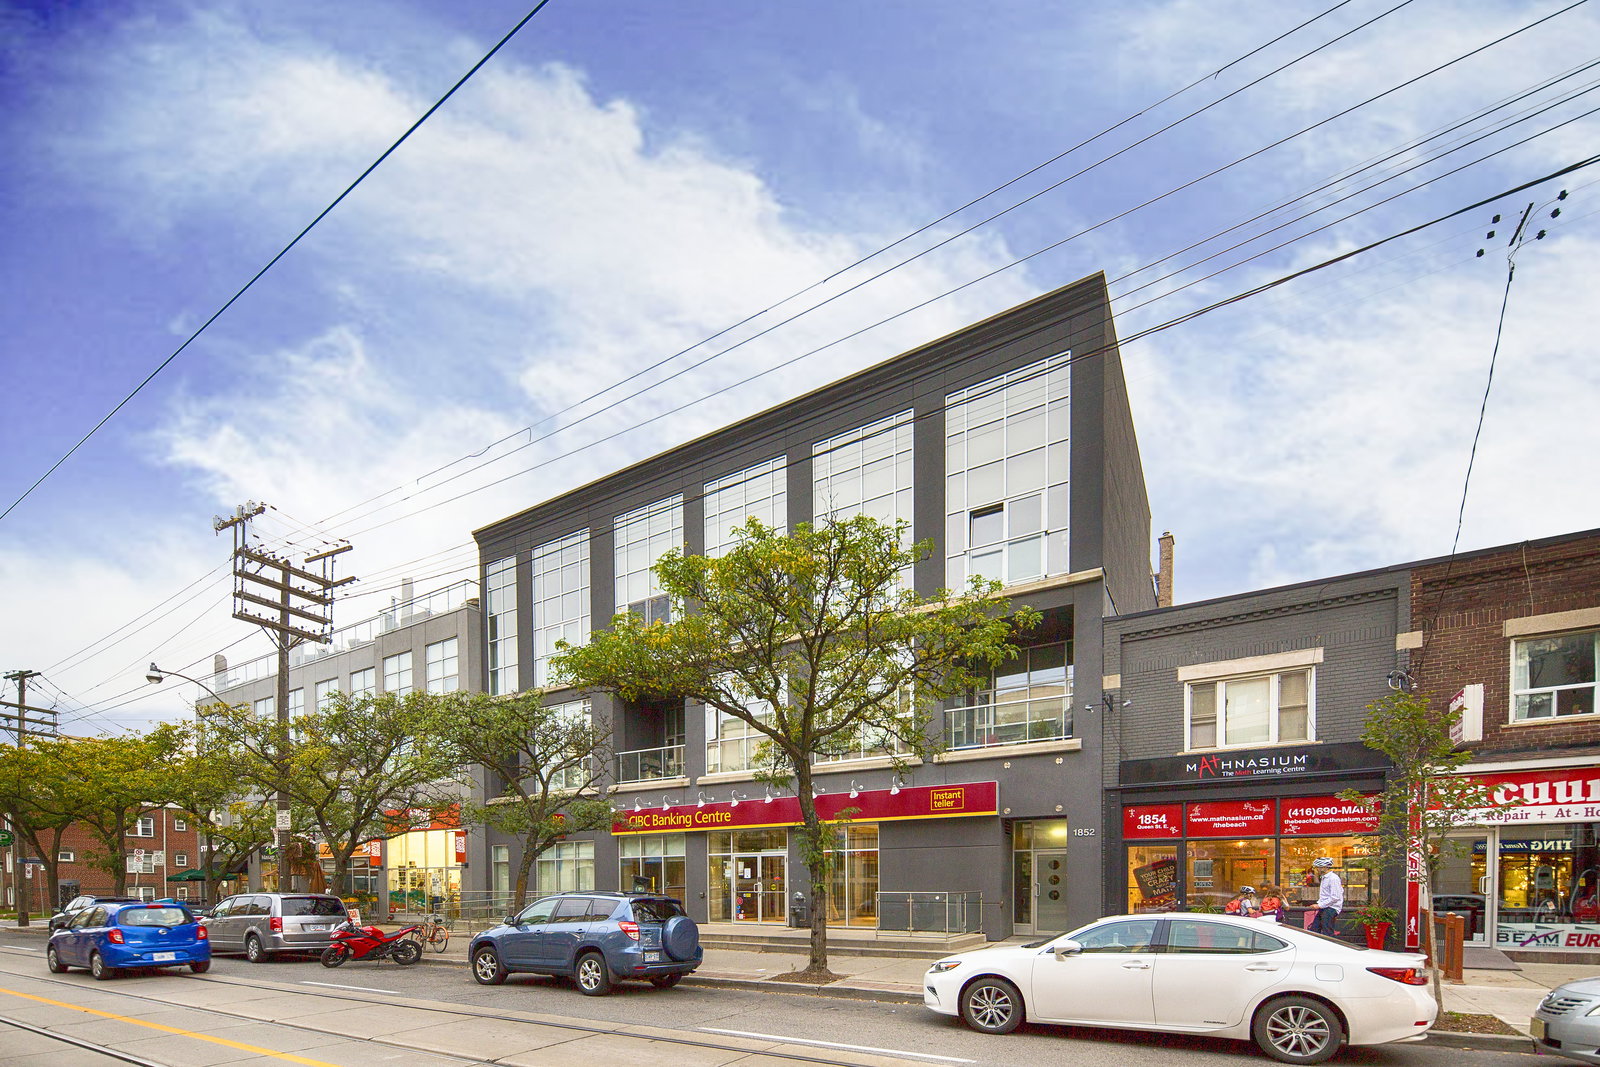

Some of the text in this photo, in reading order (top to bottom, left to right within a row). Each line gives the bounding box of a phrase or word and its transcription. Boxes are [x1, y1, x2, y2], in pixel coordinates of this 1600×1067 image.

[1253, 767, 1282, 775] Learning
[1283, 765, 1306, 773] Centre
[933, 790, 962, 800] Instant
[933, 799, 955, 808] teller
[628, 811, 731, 828] CIBC Banking Centre
[1138, 813, 1167, 825] 1854
[1191, 814, 1264, 823] www.mathnasium.ca
[1284, 816, 1377, 825] thebeach@mathnasium.com
[1486, 809, 1531, 822] Repair
[1213, 821, 1247, 829] /thebeach
[1073, 828, 1096, 837] 1852
[1147, 874, 1174, 887] CRAZY
[1496, 932, 1600, 947] BEAM EUR
